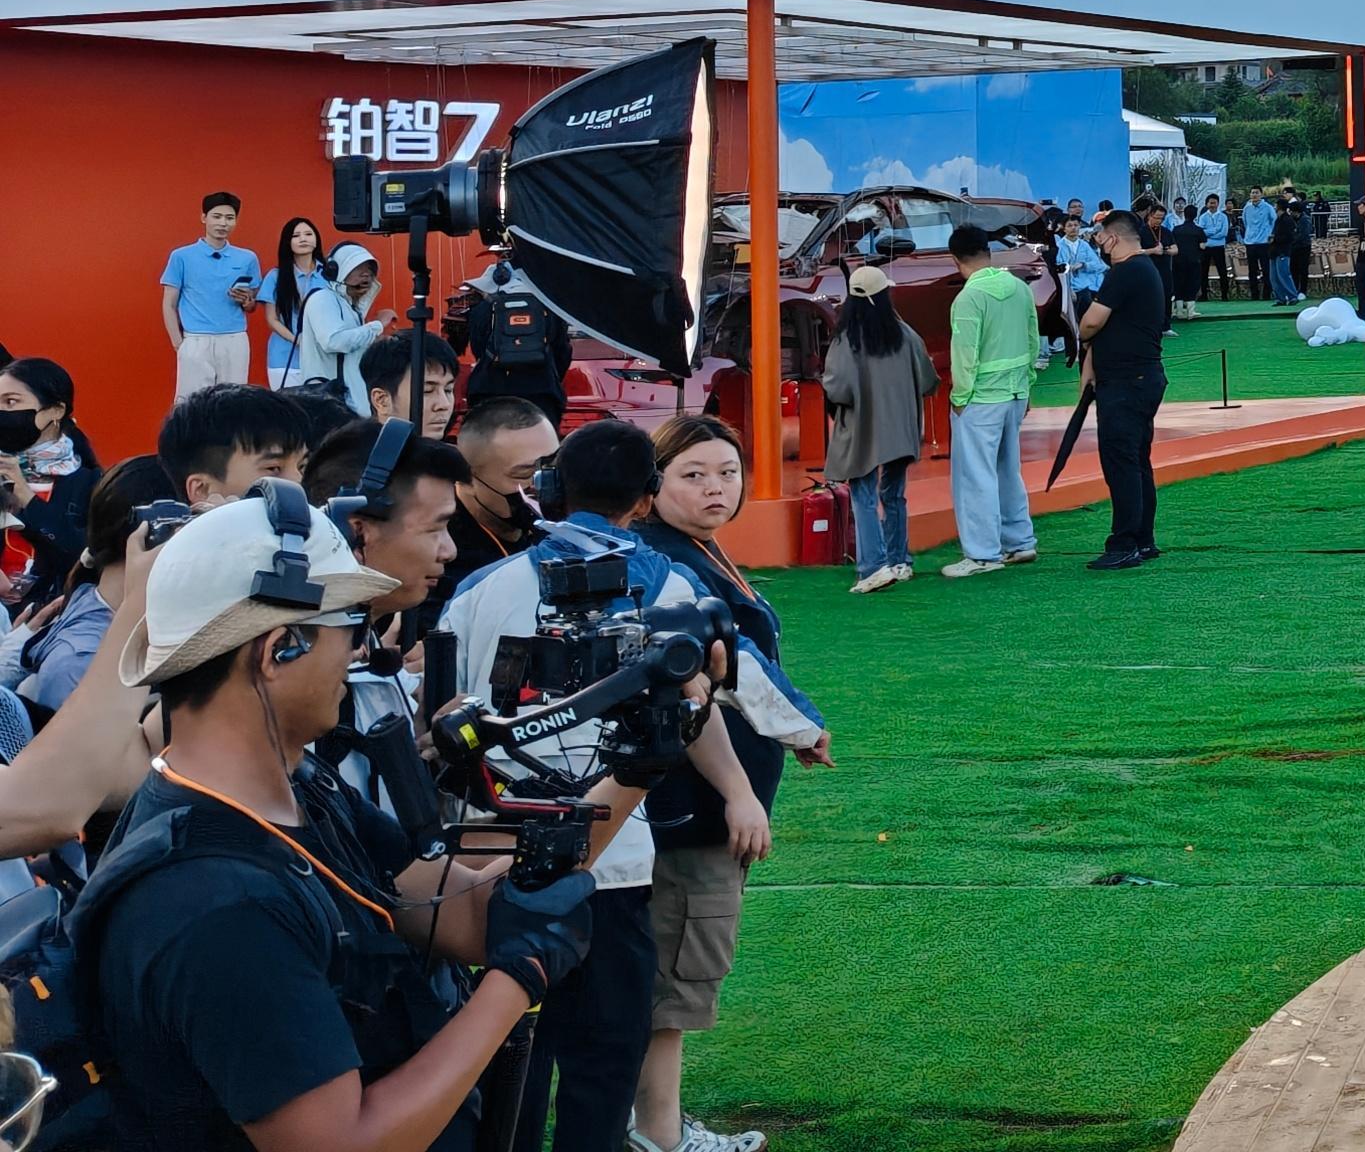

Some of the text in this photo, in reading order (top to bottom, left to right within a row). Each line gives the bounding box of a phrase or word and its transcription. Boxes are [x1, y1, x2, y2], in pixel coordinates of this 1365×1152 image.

[566, 94, 654, 127] Ulanzi
[326, 97, 501, 162] 铂智7
[511, 707, 577, 742] RONIN
